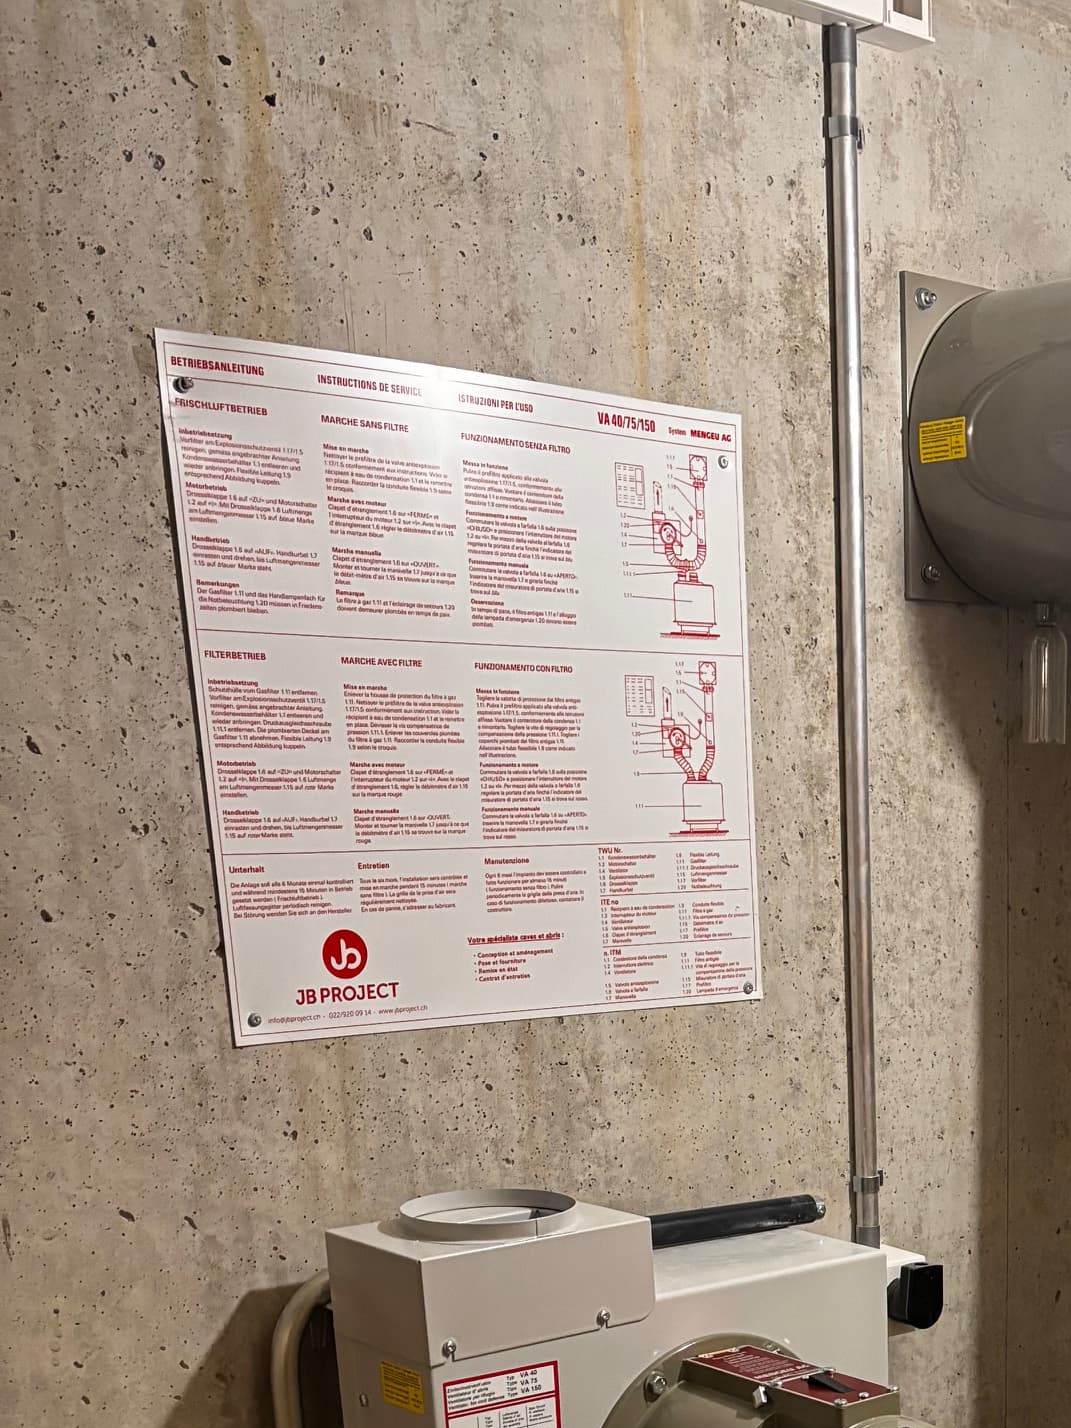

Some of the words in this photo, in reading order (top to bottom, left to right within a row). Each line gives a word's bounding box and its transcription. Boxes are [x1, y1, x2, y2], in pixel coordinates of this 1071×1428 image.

[171, 356, 265, 376] BETRIEBSANLEITUNG
[318, 374, 377, 391] INSTRUCTIONS
[379, 383, 389, 392] DE
[391, 385, 422, 396] SERVICE
[175, 398, 267, 415] FRISCHLUFTBETRIEB
[458, 393, 499, 408] ISTRUZIONI
[501, 399, 513, 410] PER
[515, 402, 533, 413] L'USO
[321, 415, 358, 427] MARCHE
[360, 419, 382, 429] SANS
[384, 423, 409, 432] FILTRE
[598, 412, 610, 426] VA
[612, 414, 655, 433] 40/75/150
[461, 433, 524, 447] FUNZIONAMENTO
[525, 440, 547, 451] SENZA
[549, 444, 570, 454] FILTRO
[690, 429, 719, 441] MENGEU
[721, 434, 731, 442] AG
[196, 579, 239, 588] Bemerkungen
[204, 650, 266, 660] FILTERBETRIEB
[341, 657, 376, 666] MARCHE
[377, 658, 397, 666] AVEC
[399, 659, 422, 667] FILTRE
[475, 663, 535, 672] FUNZIONAMENTO
[229, 866, 264, 874] Unterhalt
[296, 988, 317, 1005] JB
[320, 982, 399, 1003] PROJECT
[268, 1014, 320, 1025] info@jbproject.ch
[329, 1011, 354, 1020] 022/920
